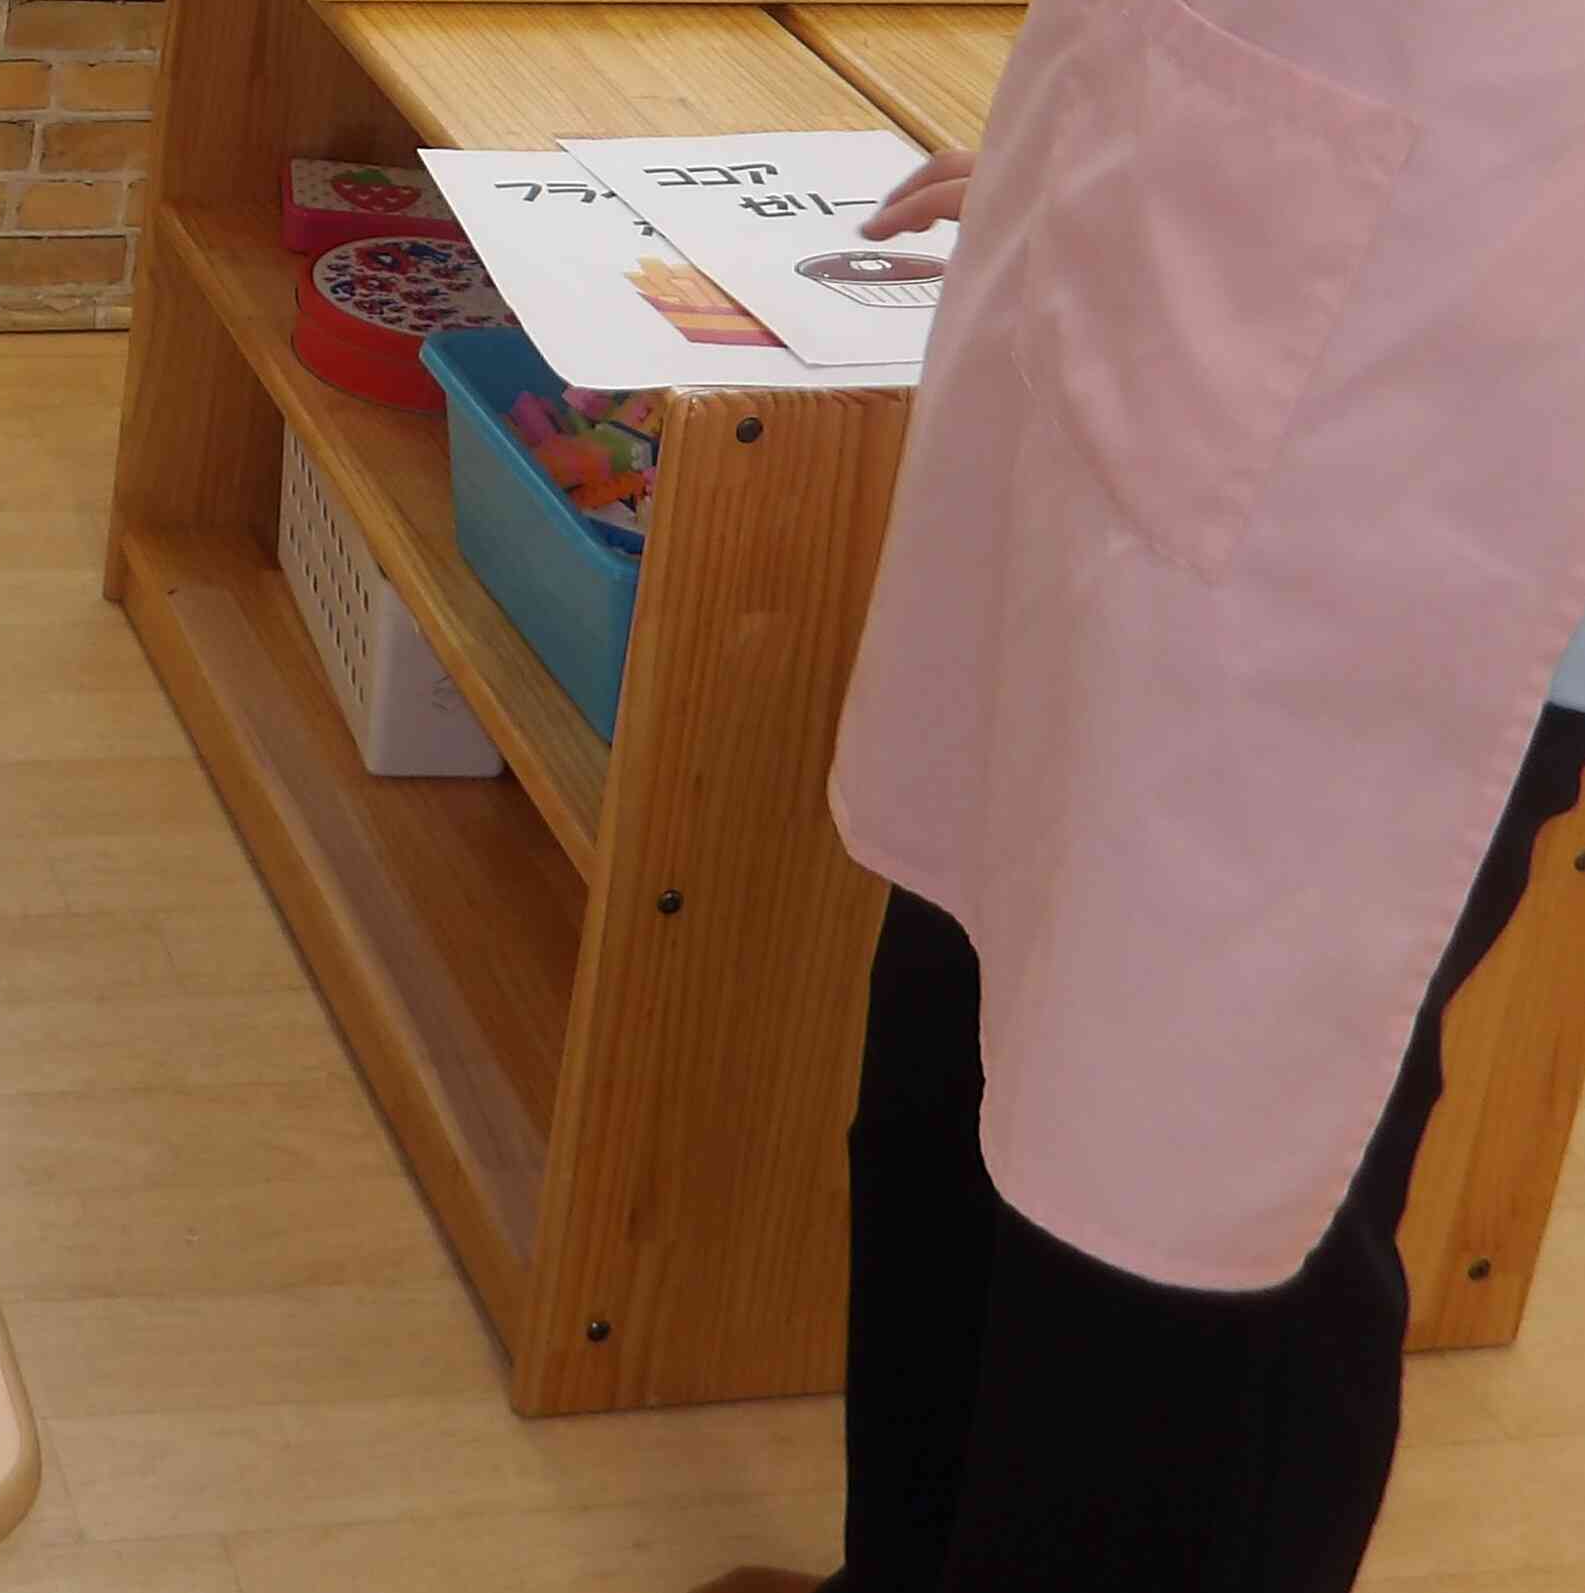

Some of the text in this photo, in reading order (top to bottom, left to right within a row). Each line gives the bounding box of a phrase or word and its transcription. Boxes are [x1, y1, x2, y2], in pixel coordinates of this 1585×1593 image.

[642, 162, 778, 186] ココア
[737, 192, 879, 217] ゼリー
